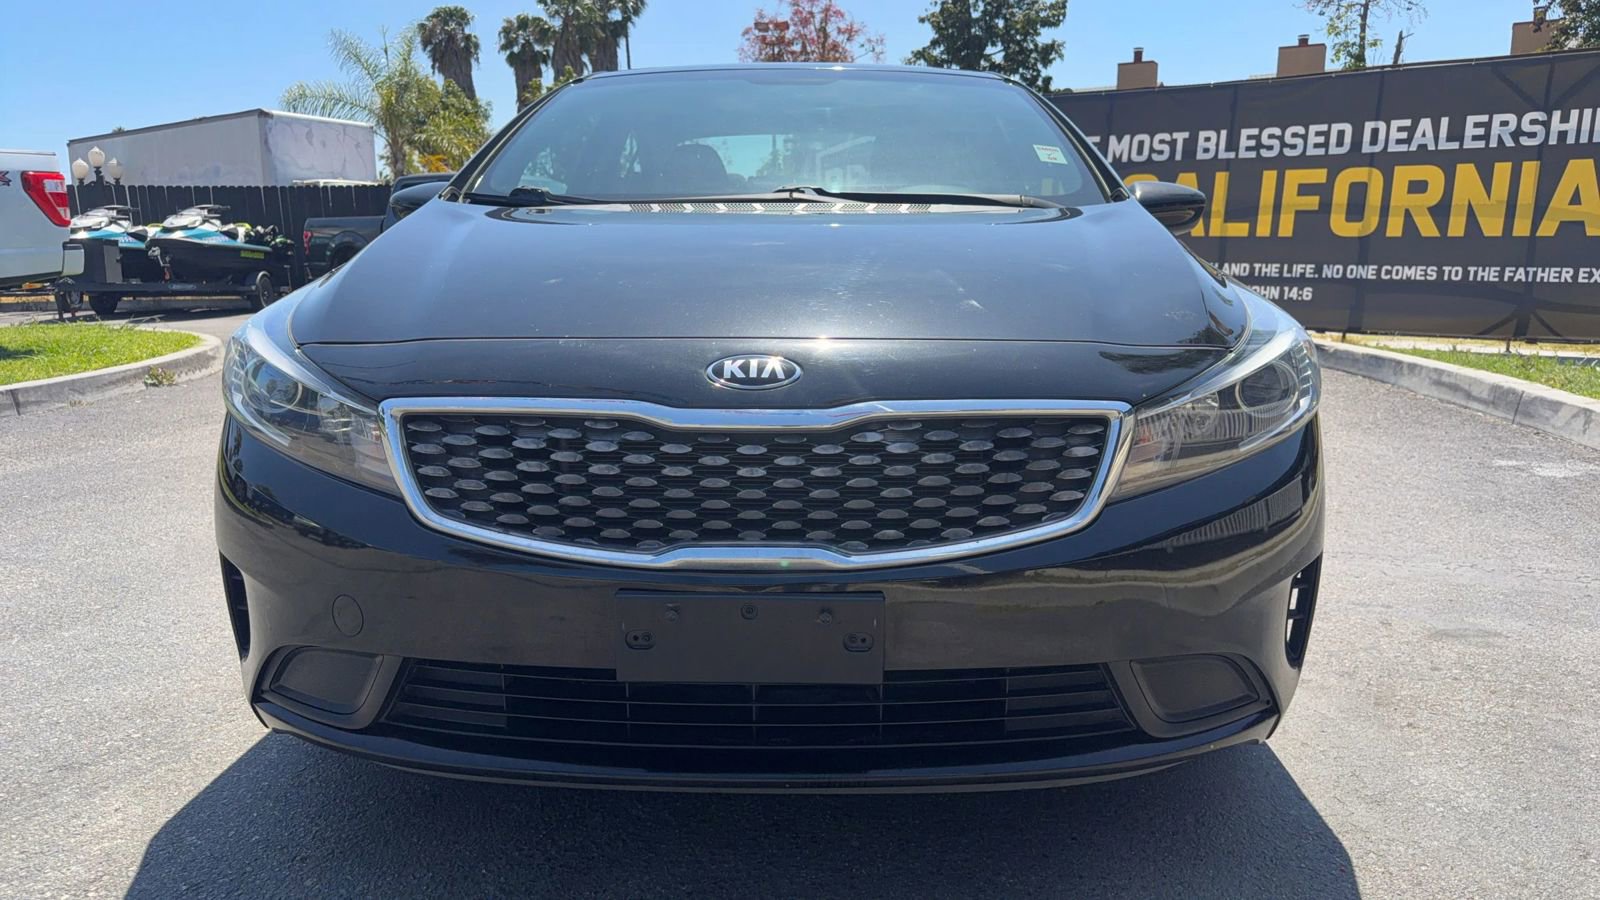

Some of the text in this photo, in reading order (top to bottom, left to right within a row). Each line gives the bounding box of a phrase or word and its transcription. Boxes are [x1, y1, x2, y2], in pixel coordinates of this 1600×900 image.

[1107, 132, 1189, 163] MOST
[1196, 122, 1353, 160] BLESSED
[1123, 158, 1600, 237] LIFORNIA
[1222, 263, 1249, 276] AND
[1253, 263, 1280, 277] THE
[1283, 264, 1318, 278] LIFE.
[1322, 264, 1343, 278] NO
[1346, 265, 1377, 279] ONE
[1381, 265, 1437, 280] COMES
[1442, 266, 1463, 280] TO
[1467, 266, 1500, 281] THE
[1504, 267, 1573, 283] FATHER
[1283, 286, 1313, 301] 14:6
[723, 359, 786, 379] KIA
